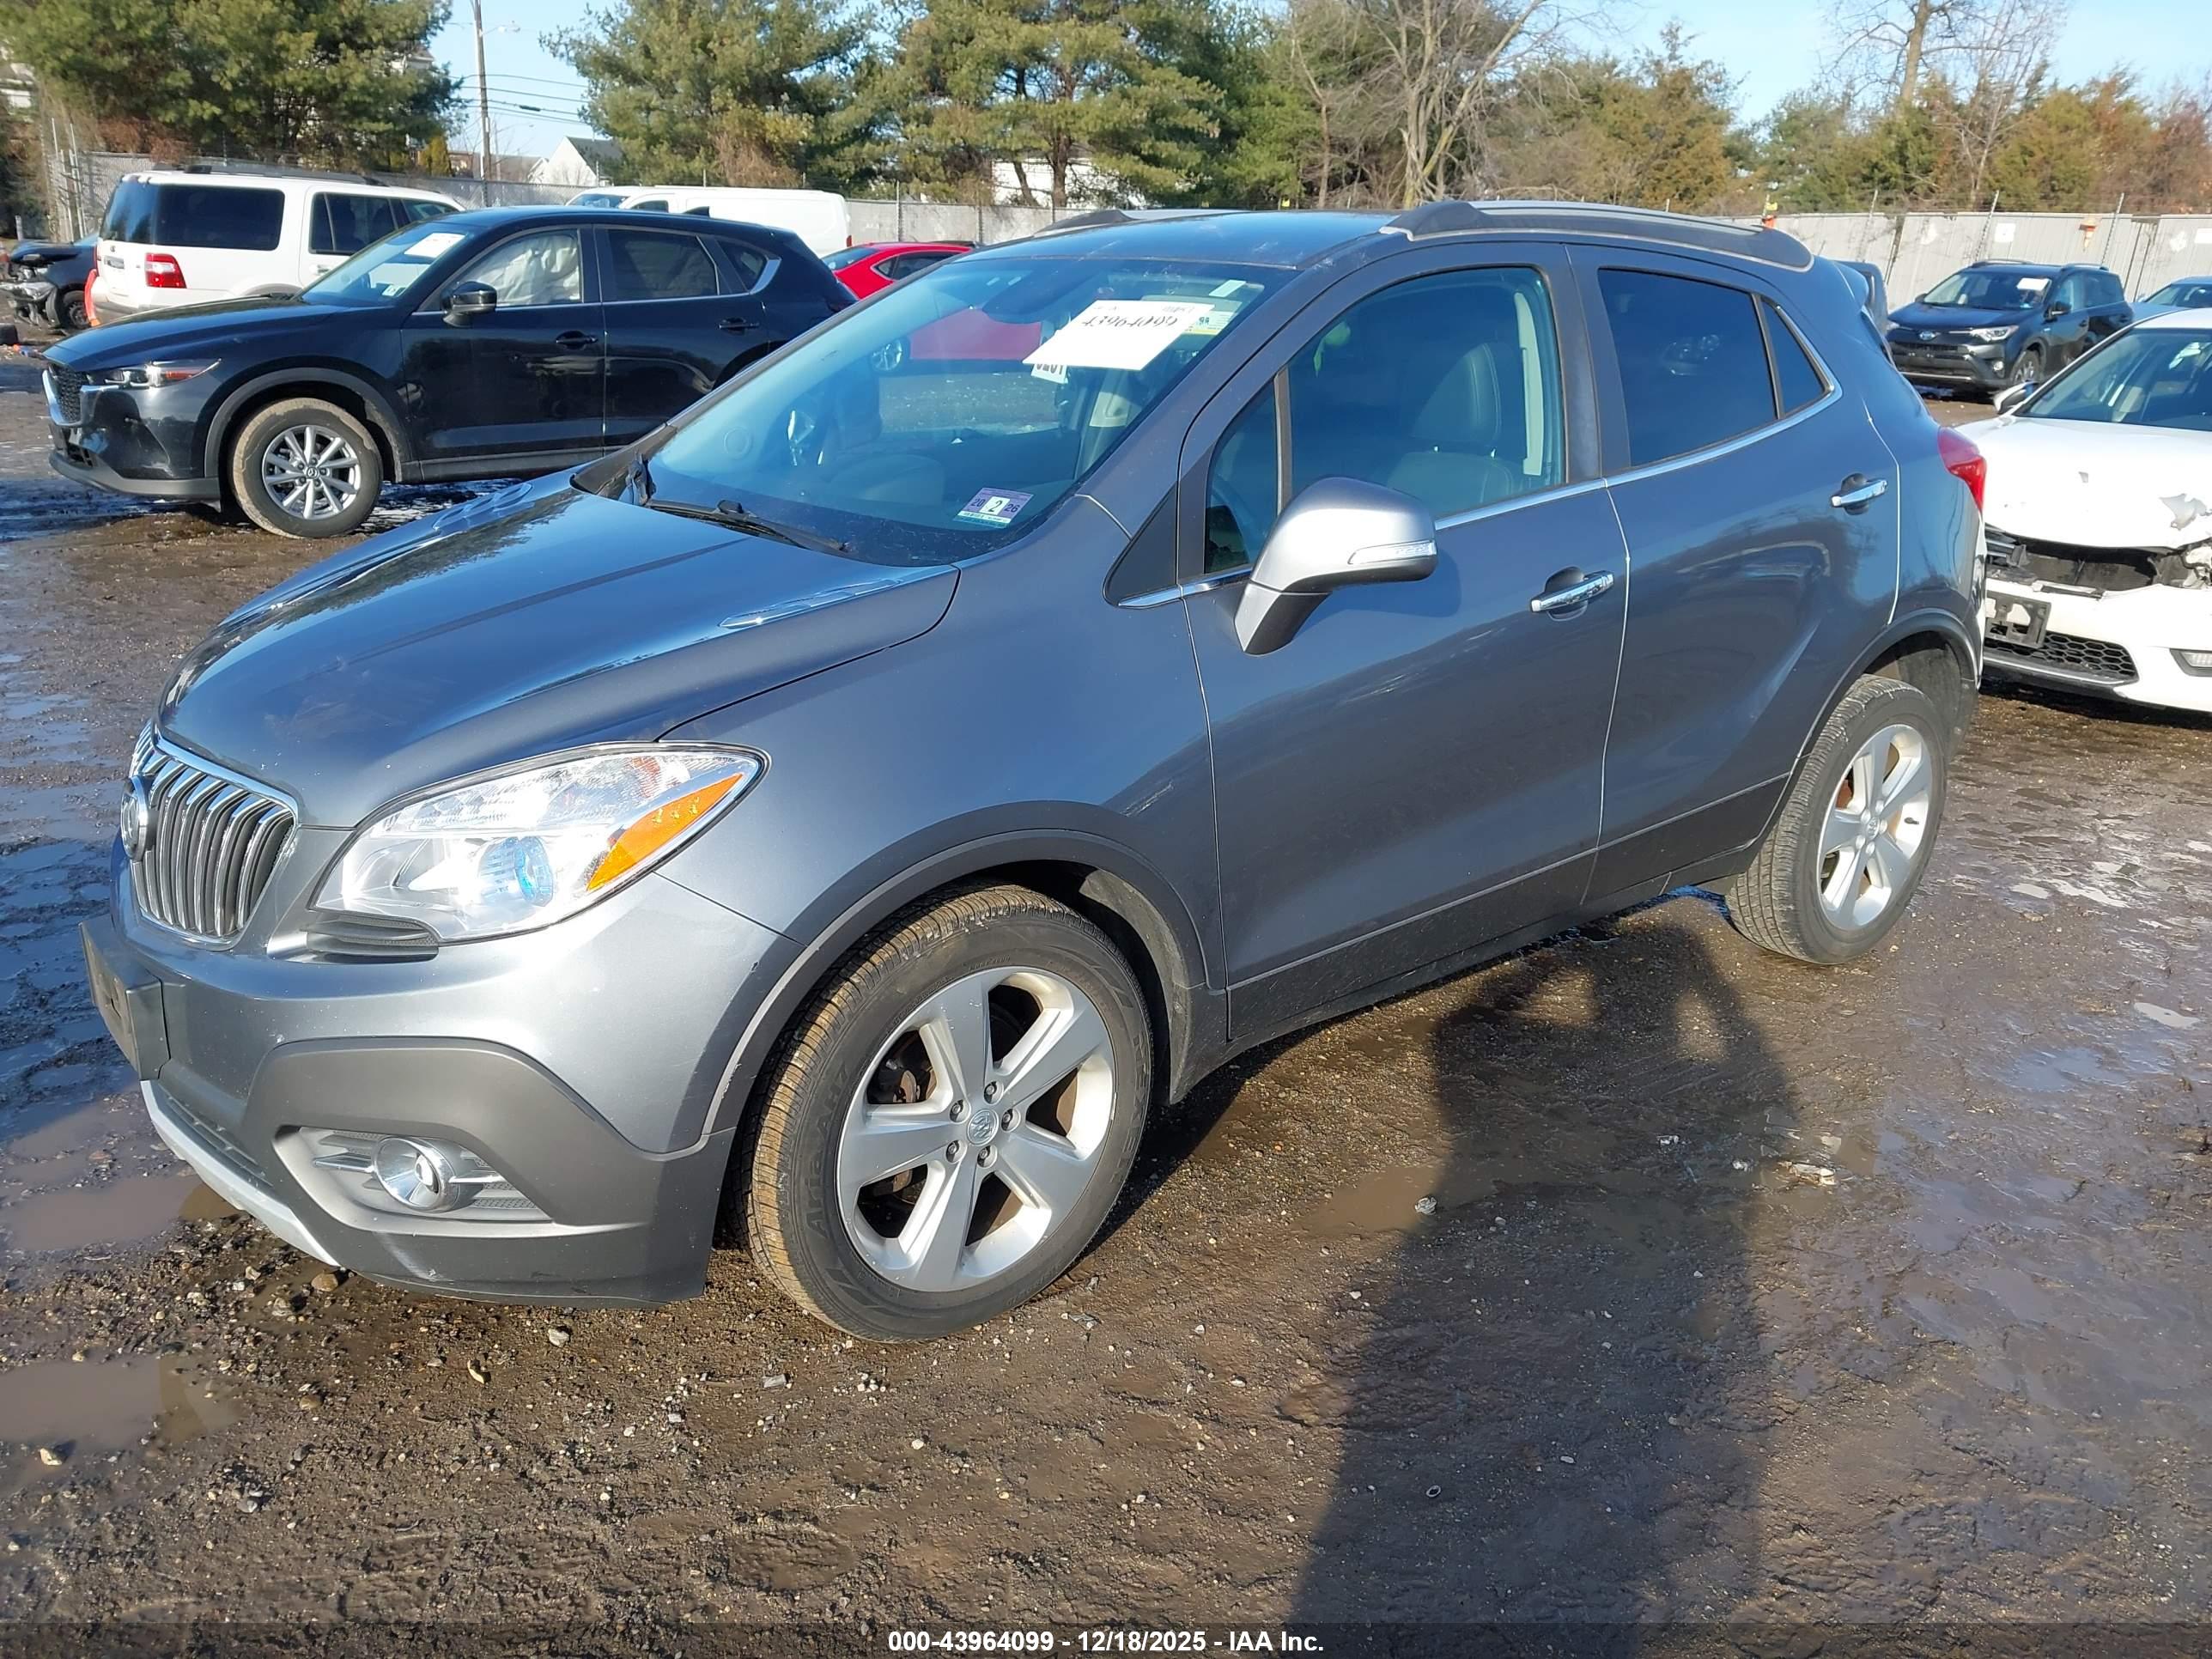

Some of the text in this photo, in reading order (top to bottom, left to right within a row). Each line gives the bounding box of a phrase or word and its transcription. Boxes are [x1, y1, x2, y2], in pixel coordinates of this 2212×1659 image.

[970, 498, 1020, 513] 20 2 26
